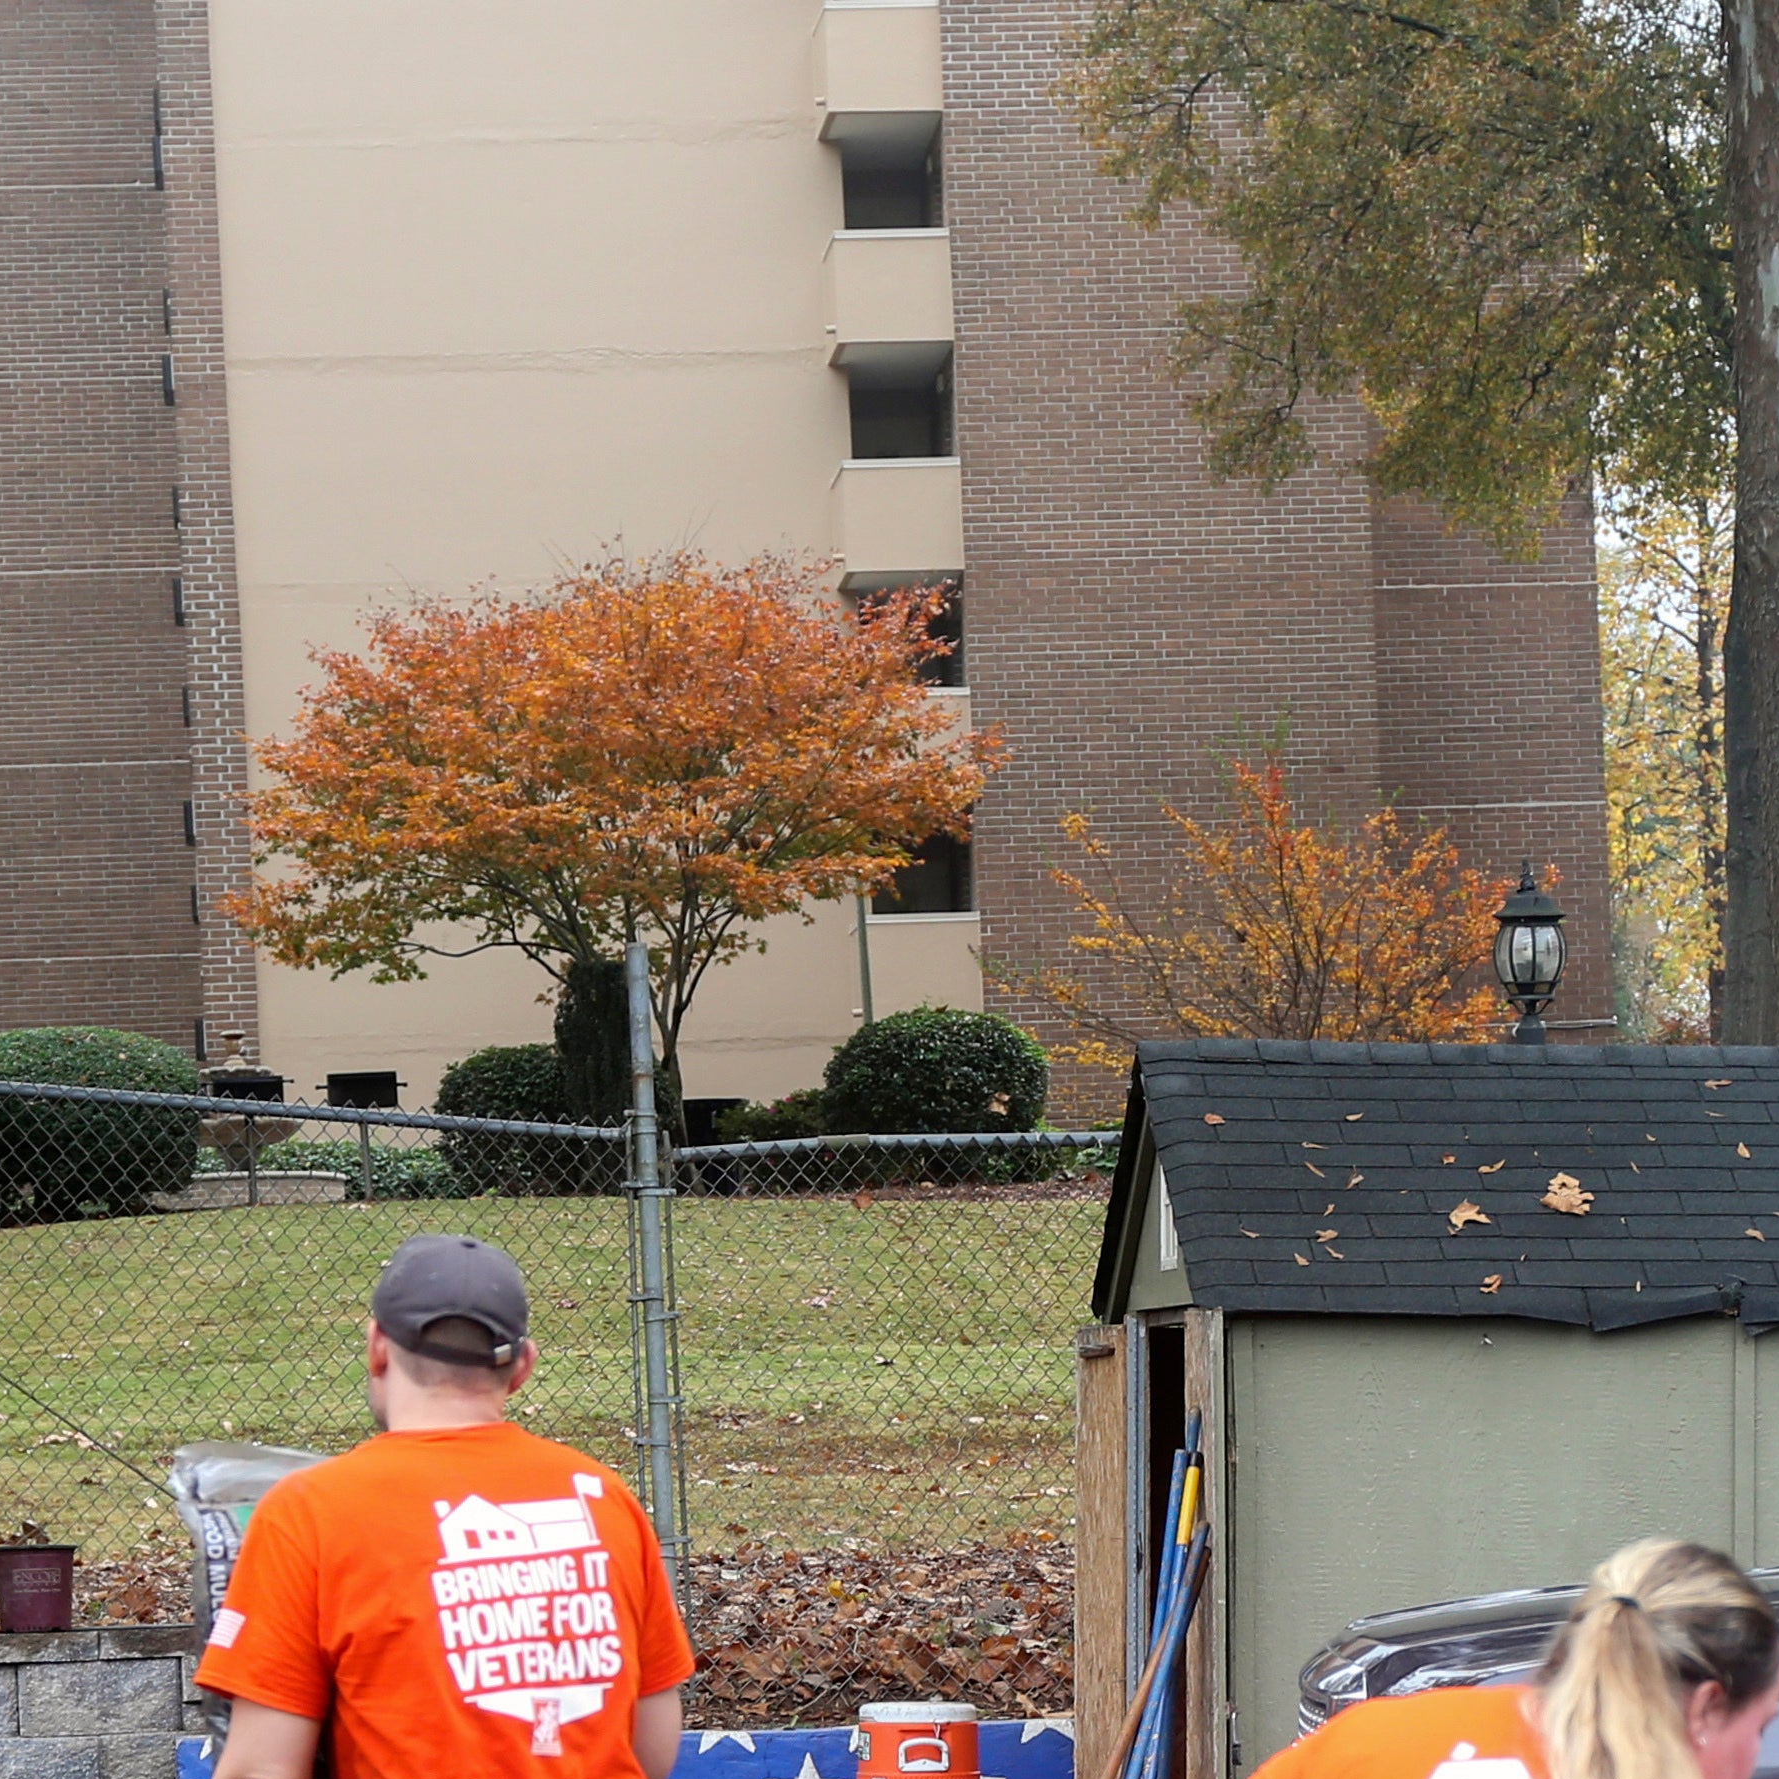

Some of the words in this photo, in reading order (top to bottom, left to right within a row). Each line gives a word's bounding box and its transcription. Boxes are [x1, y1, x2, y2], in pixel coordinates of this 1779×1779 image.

[432, 1555, 577, 1606] BRINGING
[582, 1551, 609, 1588] IT
[439, 1595, 551, 1650] HOME
[553, 1592, 617, 1636] FOR
[447, 1636, 622, 1692] VETERANS
